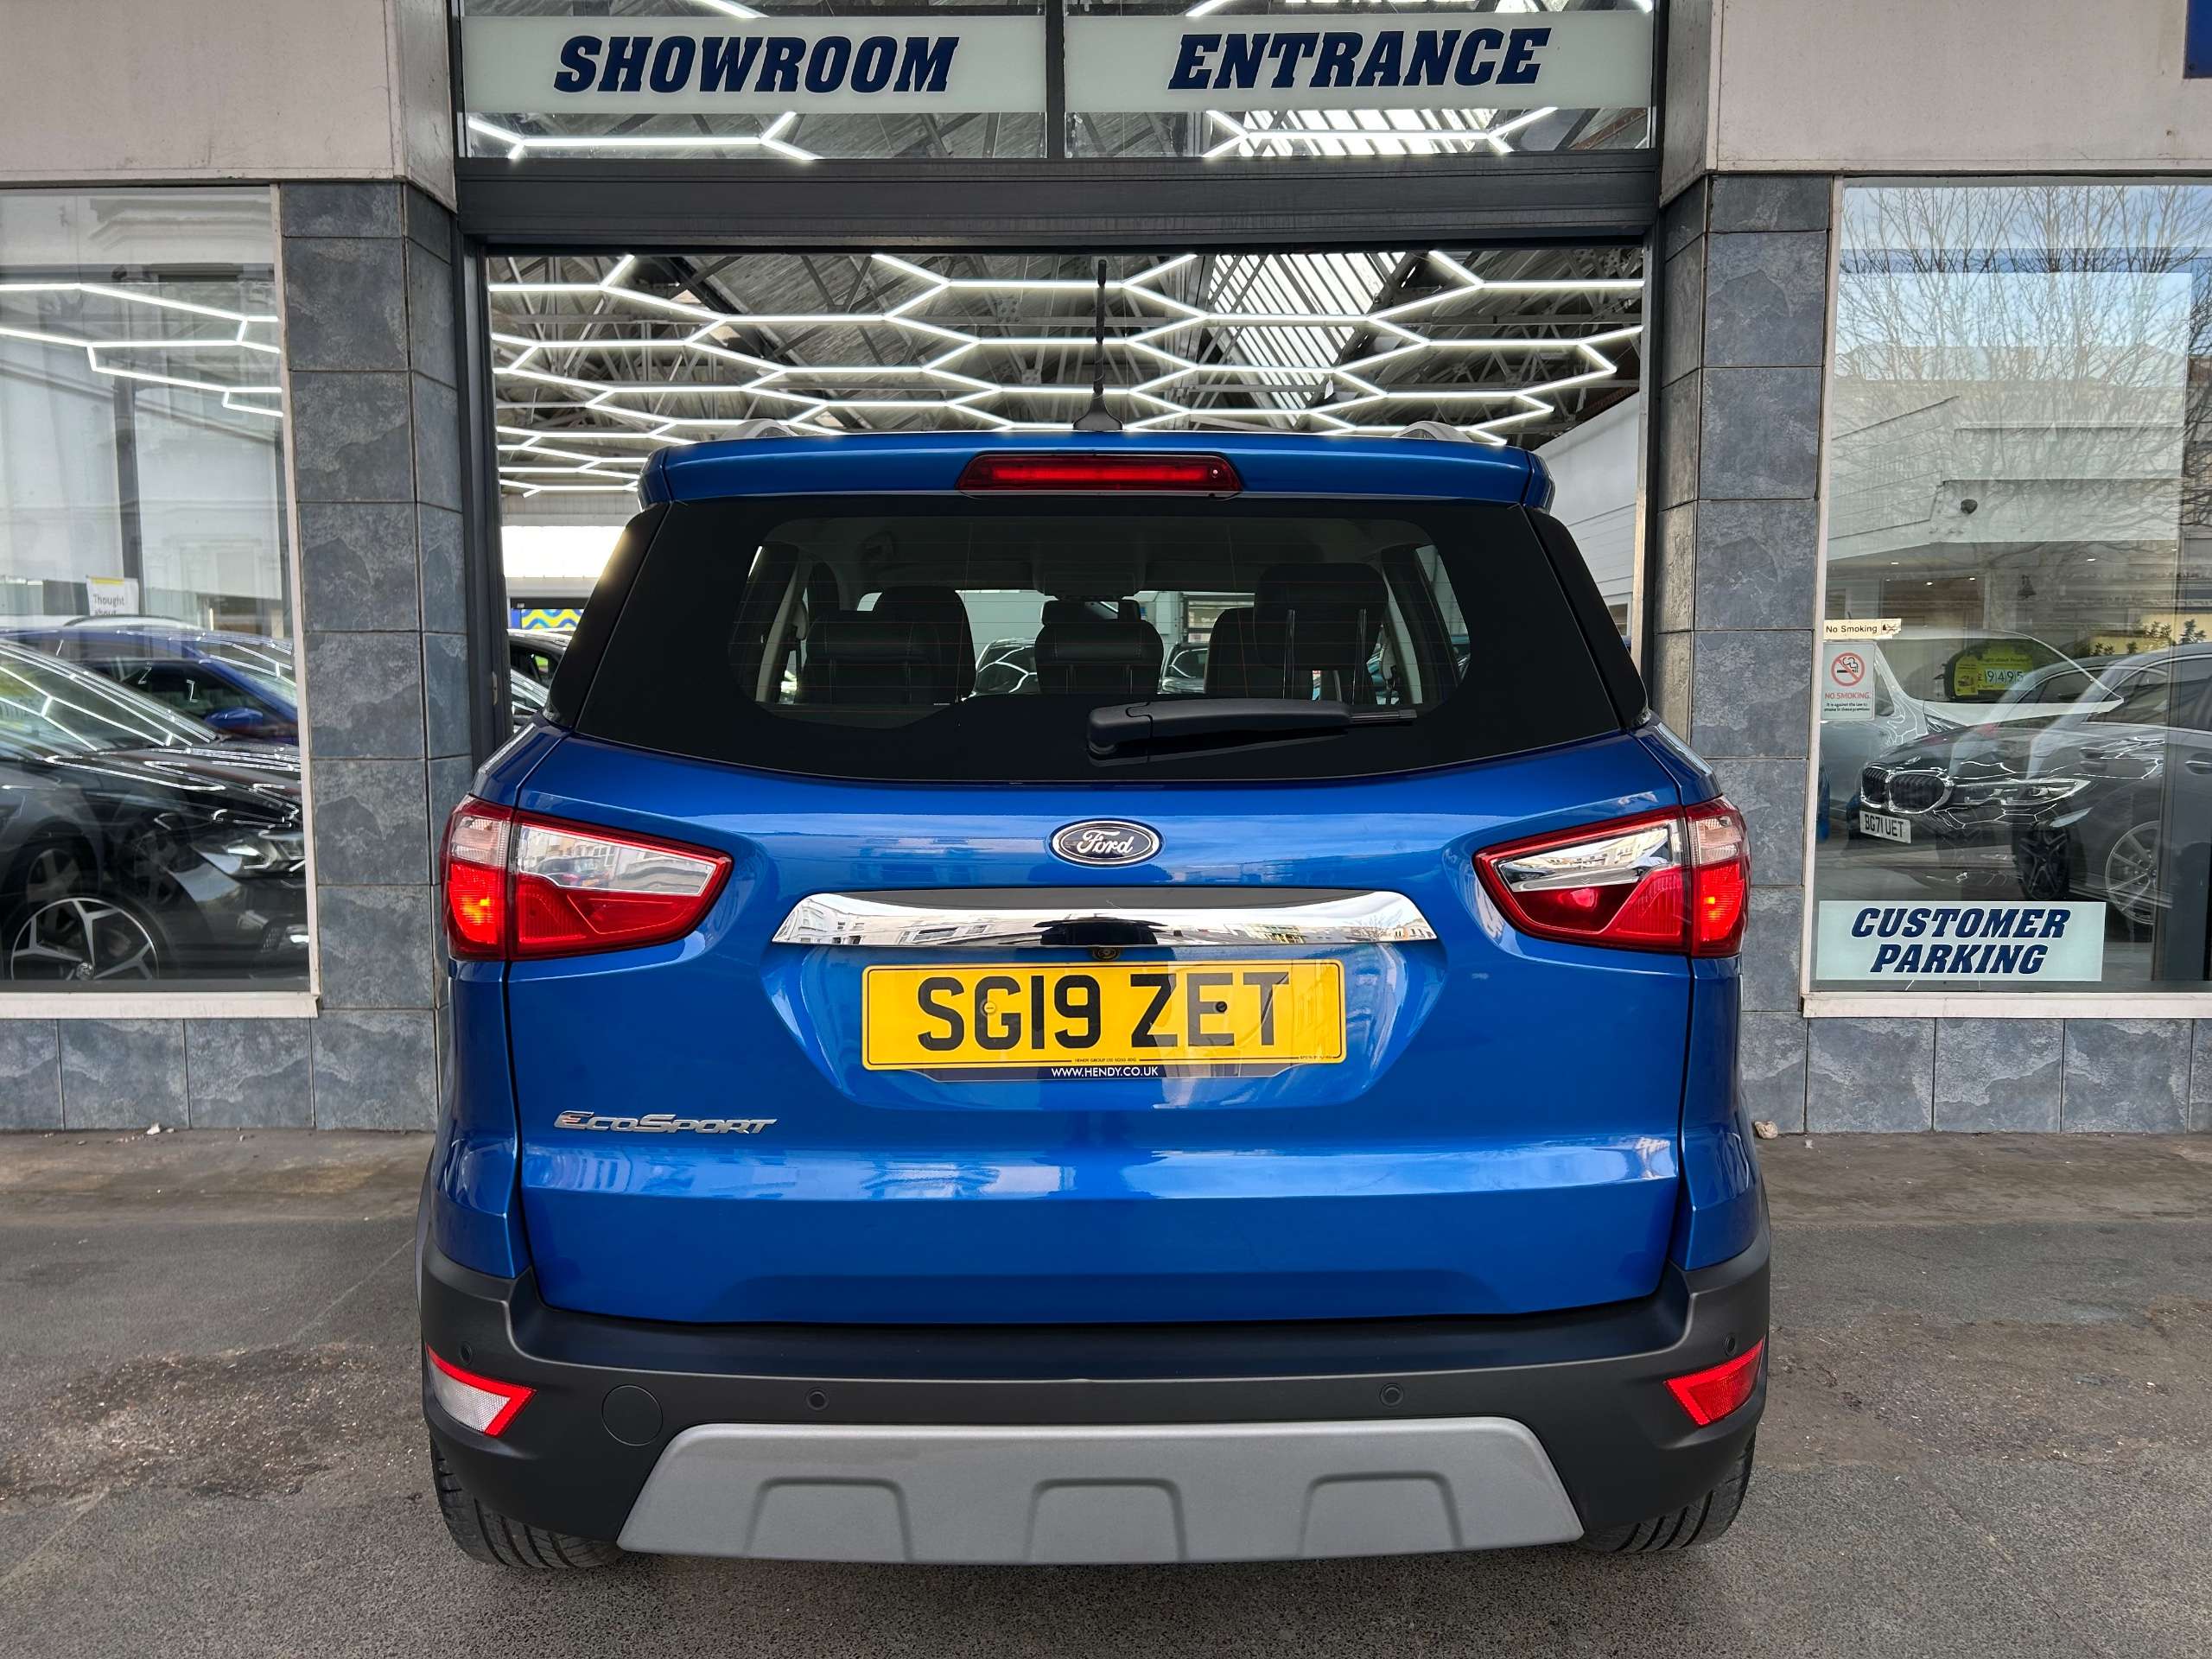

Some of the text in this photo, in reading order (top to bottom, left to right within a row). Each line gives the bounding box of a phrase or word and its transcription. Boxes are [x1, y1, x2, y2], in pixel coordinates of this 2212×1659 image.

[554, 28, 1552, 93] SHOWROOM ENTRANCE
[93, 594, 124, 607] Thought
[1841, 625, 1878, 633] Smoking
[1865, 814, 1904, 837] BG71 UET
[1077, 830, 1135, 854] Ford
[1851, 908, 2071, 938] CUSTOMER
[1870, 944, 2048, 975] PARKING
[918, 971, 1288, 1051] SG19 ZET
[1052, 1066, 1159, 1077] WWW.HENDY.CO.UK
